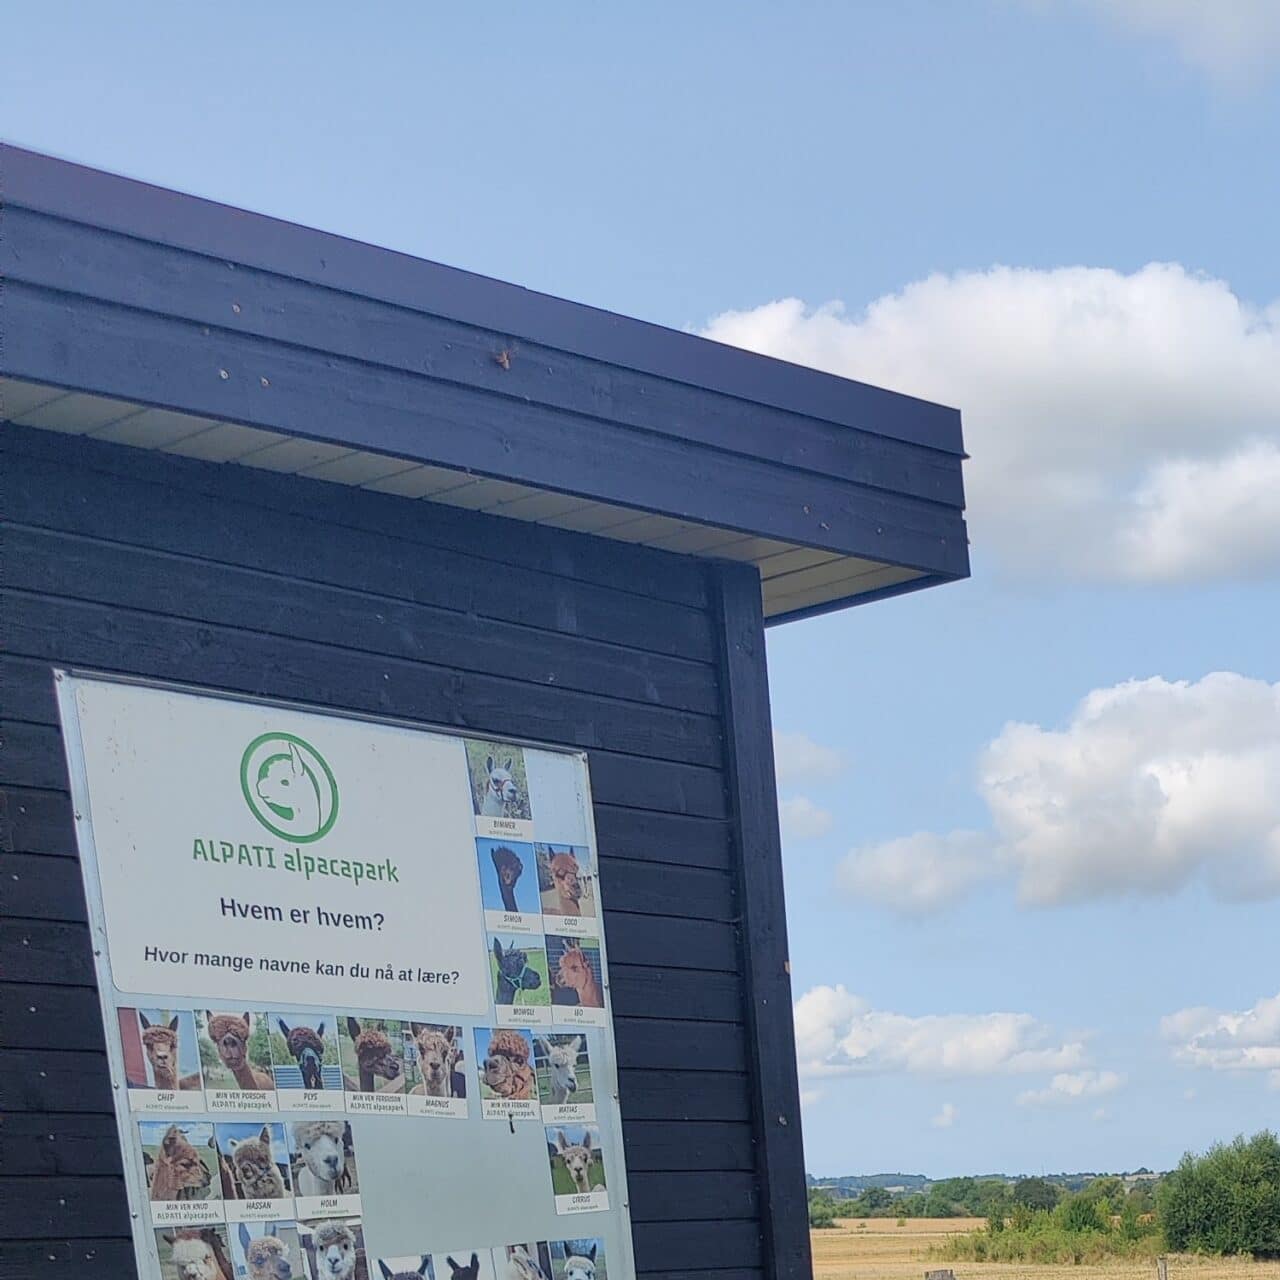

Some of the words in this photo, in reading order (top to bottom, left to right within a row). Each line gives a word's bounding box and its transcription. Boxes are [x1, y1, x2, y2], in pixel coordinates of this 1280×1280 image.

[192, 838, 277, 869] ALPATI
[283, 847, 400, 886] alpacapark
[220, 897, 283, 922] Hvem
[289, 907, 311, 924] er
[316, 906, 385, 931] hvem?
[563, 918, 578, 927] COCO
[144, 946, 189, 964] Hvor
[193, 950, 254, 972] mange
[259, 956, 310, 974] navne
[315, 959, 345, 977] kan
[349, 963, 370, 980] du
[374, 963, 394, 981] nå
[398, 968, 413, 982] at
[417, 968, 460, 985] lære?
[157, 1093, 175, 1102] CHIP
[215, 1092, 228, 1100] MIN
[229, 1092, 240, 1100] VEN
[241, 1092, 266, 1100] PORSCHE
[303, 1092, 318, 1101] PLYS
[426, 1099, 449, 1109] MAGNUS
[166, 1203, 178, 1211] MIN
[180, 1203, 191, 1211] VEN
[246, 1201, 272, 1210] HASSAN
[320, 1199, 338, 1208] HOLM
